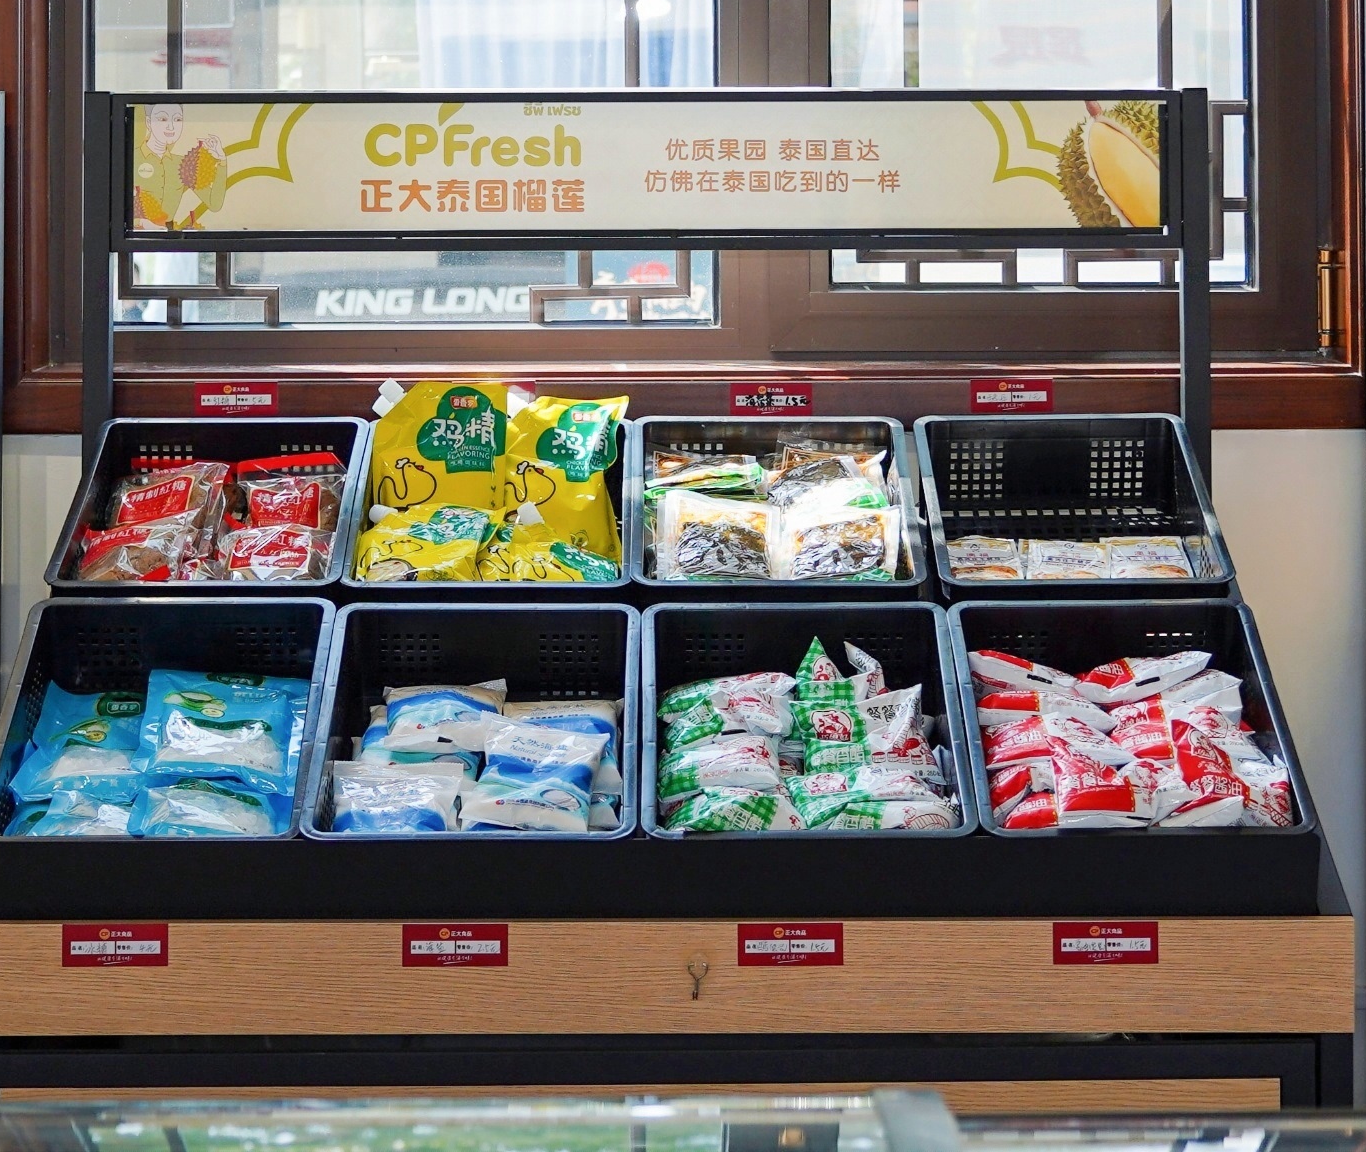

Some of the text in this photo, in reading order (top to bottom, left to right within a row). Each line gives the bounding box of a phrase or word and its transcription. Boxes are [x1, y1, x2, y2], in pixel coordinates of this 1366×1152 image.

[364, 122, 582, 167] CPFresh
[664, 138, 881, 162] 优质果园 泰国直达
[643, 169, 902, 194] 仿佛在泰国吃到的一样
[360, 179, 586, 214] 正大泰国榴莲
[315, 286, 530, 317] KING LONG
[431, 410, 496, 449] 鸡精
[446, 450, 491, 460] FLAVORING
[512, 735, 568, 752] 天然海盐
[451, 930, 473, 938] 正大食品
